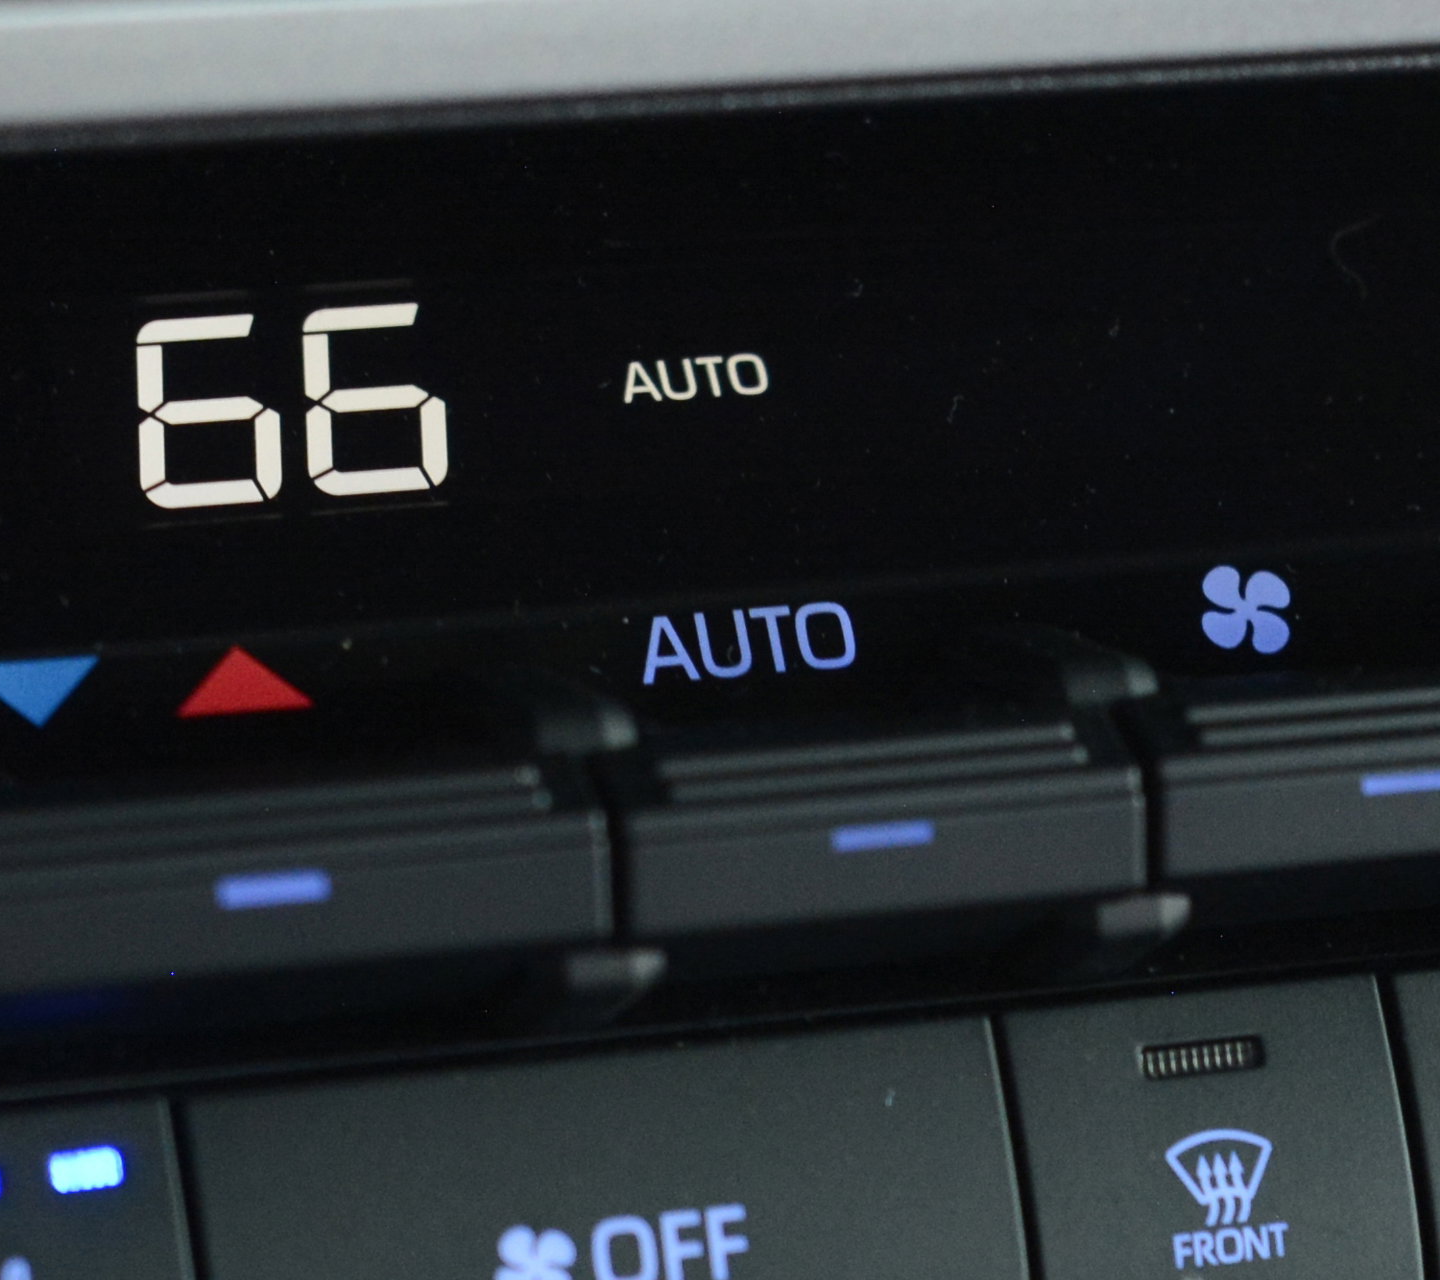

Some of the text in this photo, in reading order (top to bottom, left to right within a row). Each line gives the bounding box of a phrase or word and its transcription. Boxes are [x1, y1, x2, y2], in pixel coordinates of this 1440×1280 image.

[135, 301, 450, 510] 66
[622, 352, 770, 404] AUTO
[641, 600, 858, 685] AUTO
[1171, 1220, 1290, 1270] FRONT
